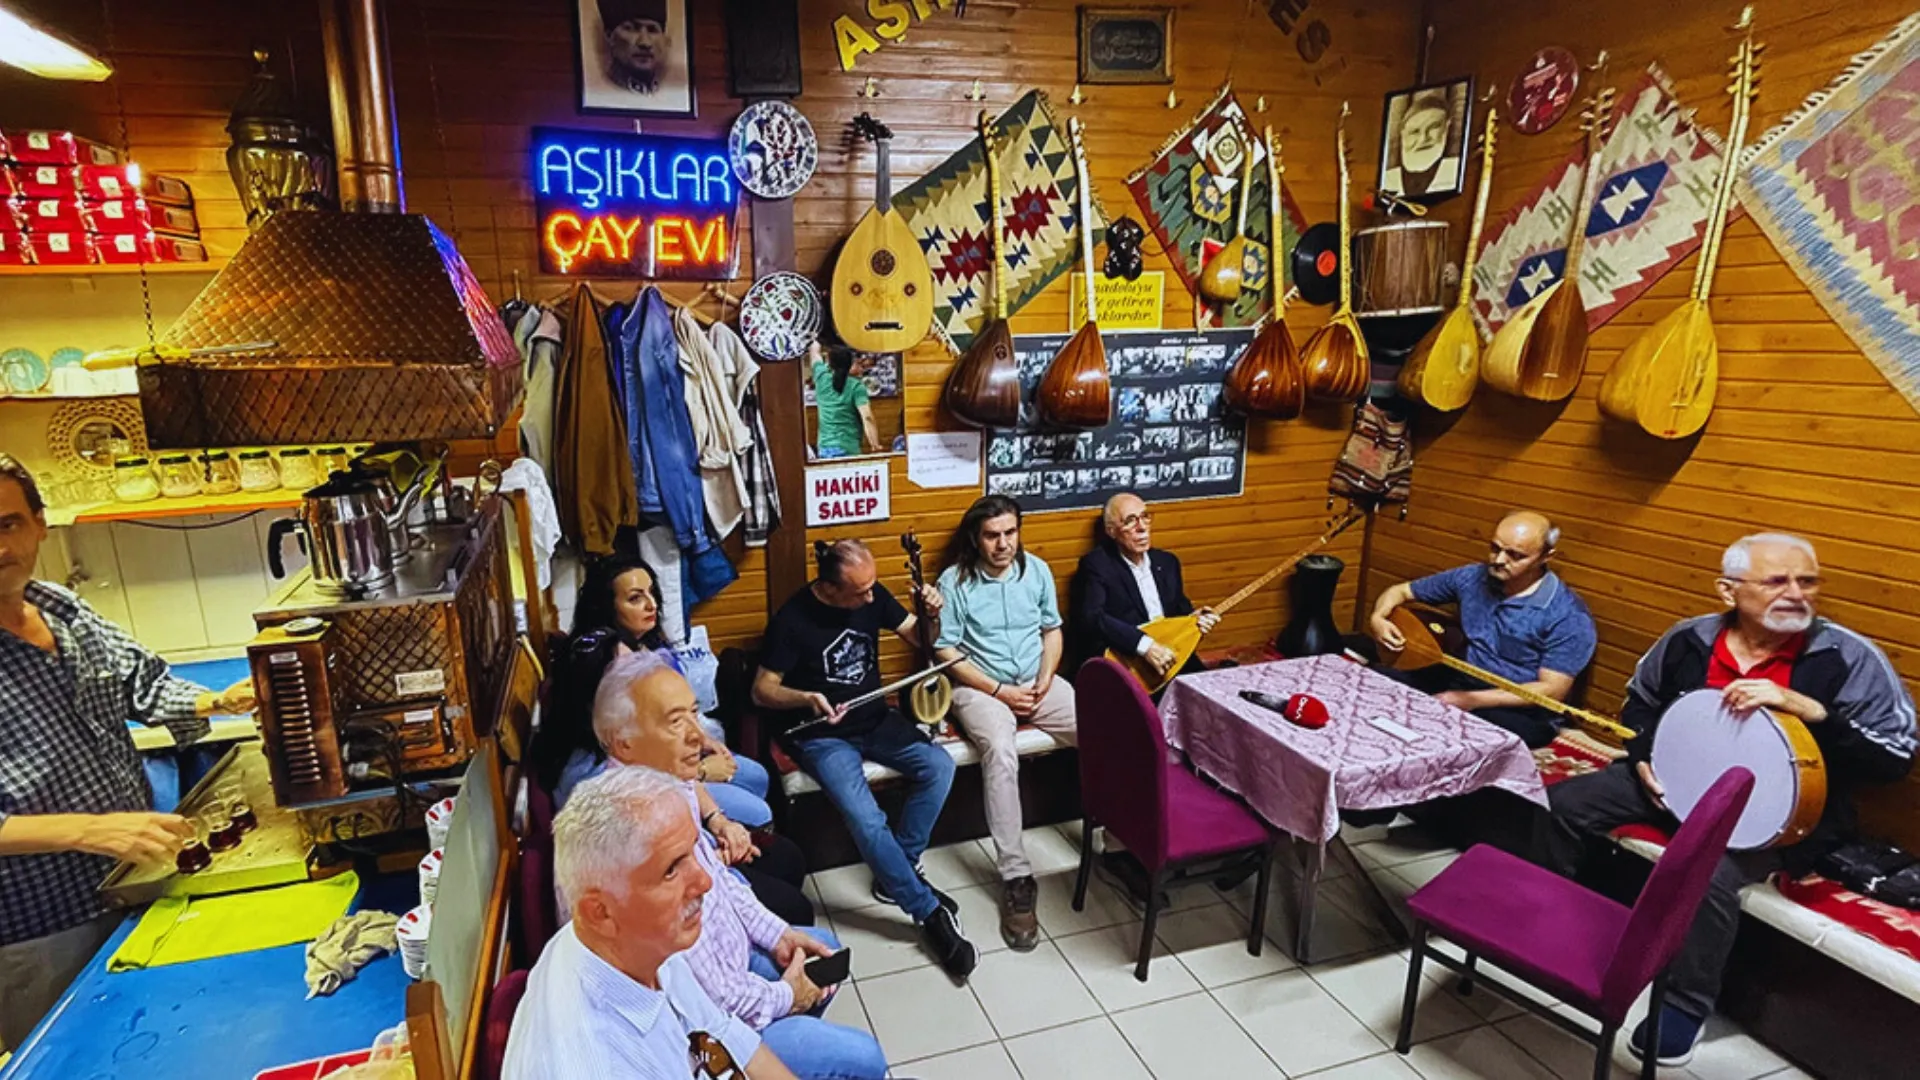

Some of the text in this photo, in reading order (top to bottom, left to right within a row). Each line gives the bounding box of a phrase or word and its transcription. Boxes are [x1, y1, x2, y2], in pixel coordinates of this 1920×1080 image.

[541, 144, 731, 208] AŞIKLAR
[549, 213, 726, 274] ÇAY EVİ
[1084, 281, 1153, 296] nadolu'yu
[1107, 295, 1155, 309] getiren
[815, 469, 879, 498] HAKİKİ
[818, 497, 878, 520] SALEP
